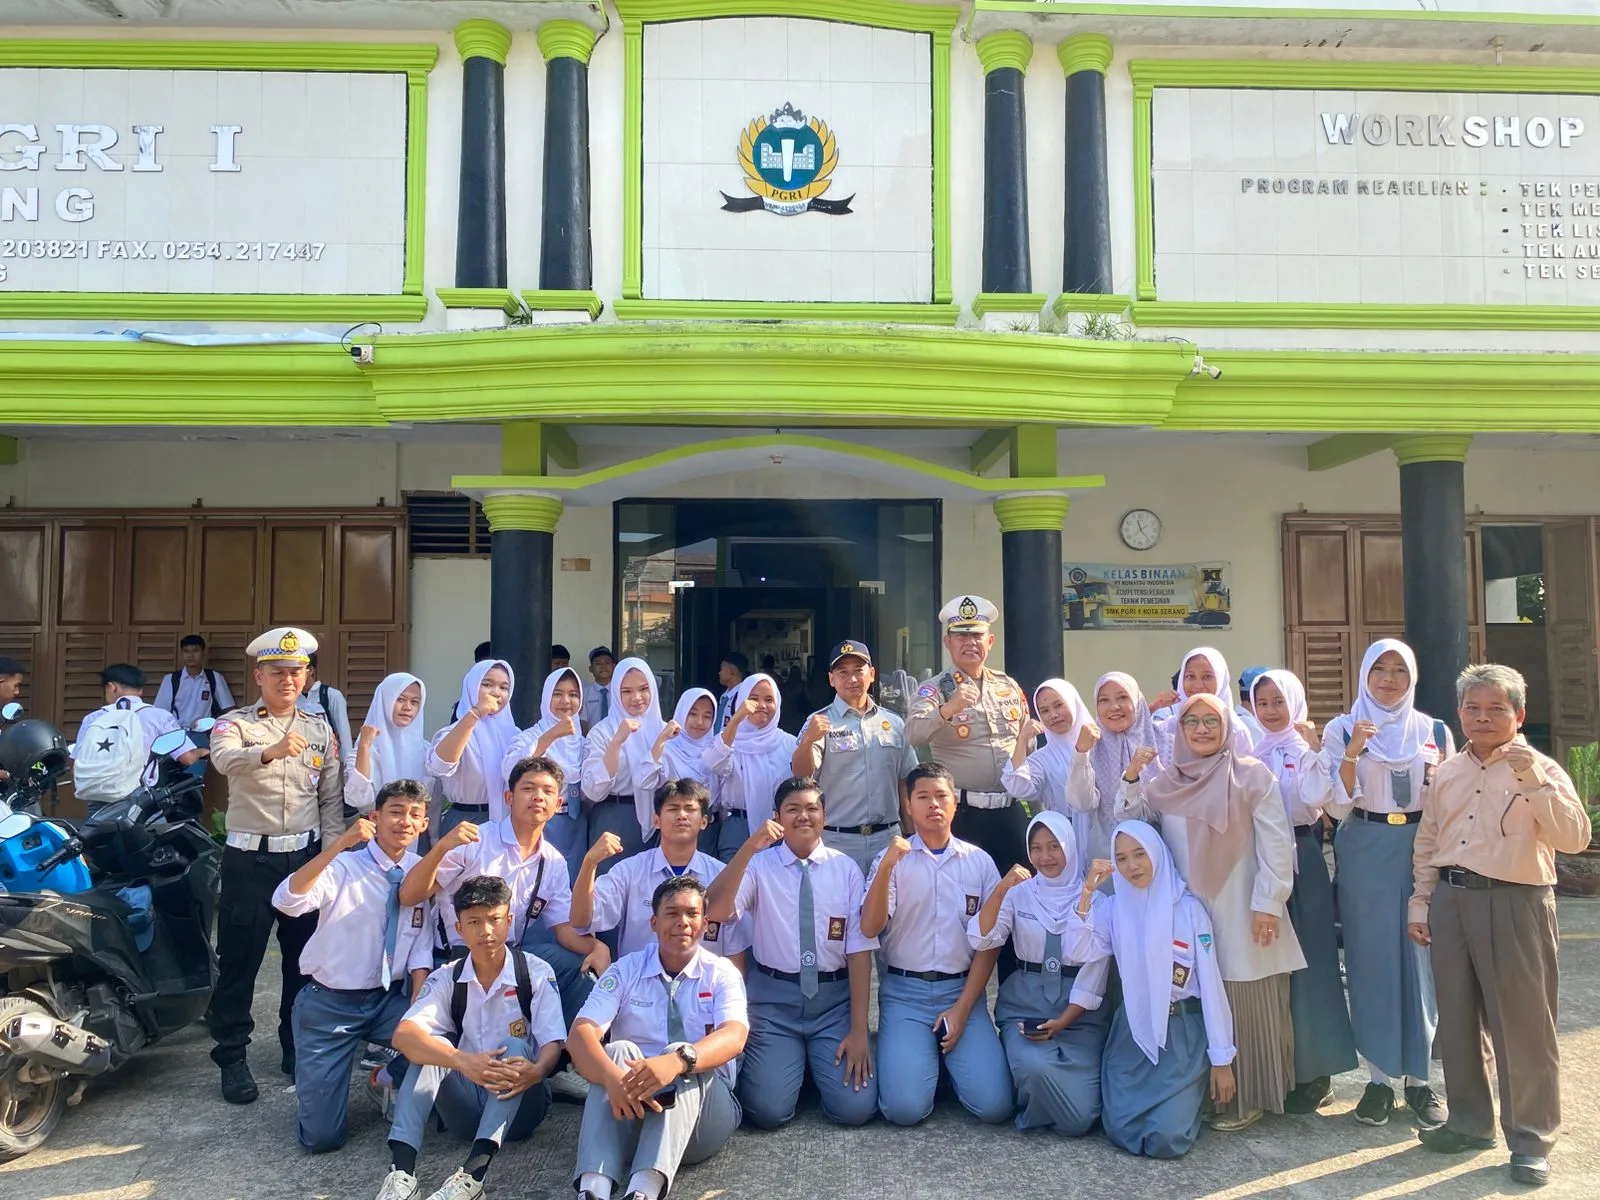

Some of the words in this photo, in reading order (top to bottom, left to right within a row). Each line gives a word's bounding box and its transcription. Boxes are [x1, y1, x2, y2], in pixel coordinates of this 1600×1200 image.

[1321, 112, 1585, 149] WORKSHOP
[771, 189, 803, 201] PGRI
[1241, 178, 1350, 196] PROGRAM
[1357, 180, 1469, 198] KEAHLIAN
[1519, 182, 1562, 198] TEK
[1570, 183, 1600, 199] PE
[1520, 202, 1563, 218] TEK
[1521, 223, 1565, 238] TEK
[2, 239, 89, 259] 203821
[97, 240, 157, 261] FAX.
[1522, 243, 1565, 259] TEK
[1523, 263, 1567, 279] TEK
[1104, 569, 1138, 580] KELAS
[1140, 569, 1187, 580] BINAAN
[1120, 597, 1140, 605] TEKNIK
[1105, 608, 1120, 616] SMK
[1121, 608, 1136, 616] PGRI
[1143, 608, 1159, 616] KOTA
[1160, 608, 1187, 616] SERANG
